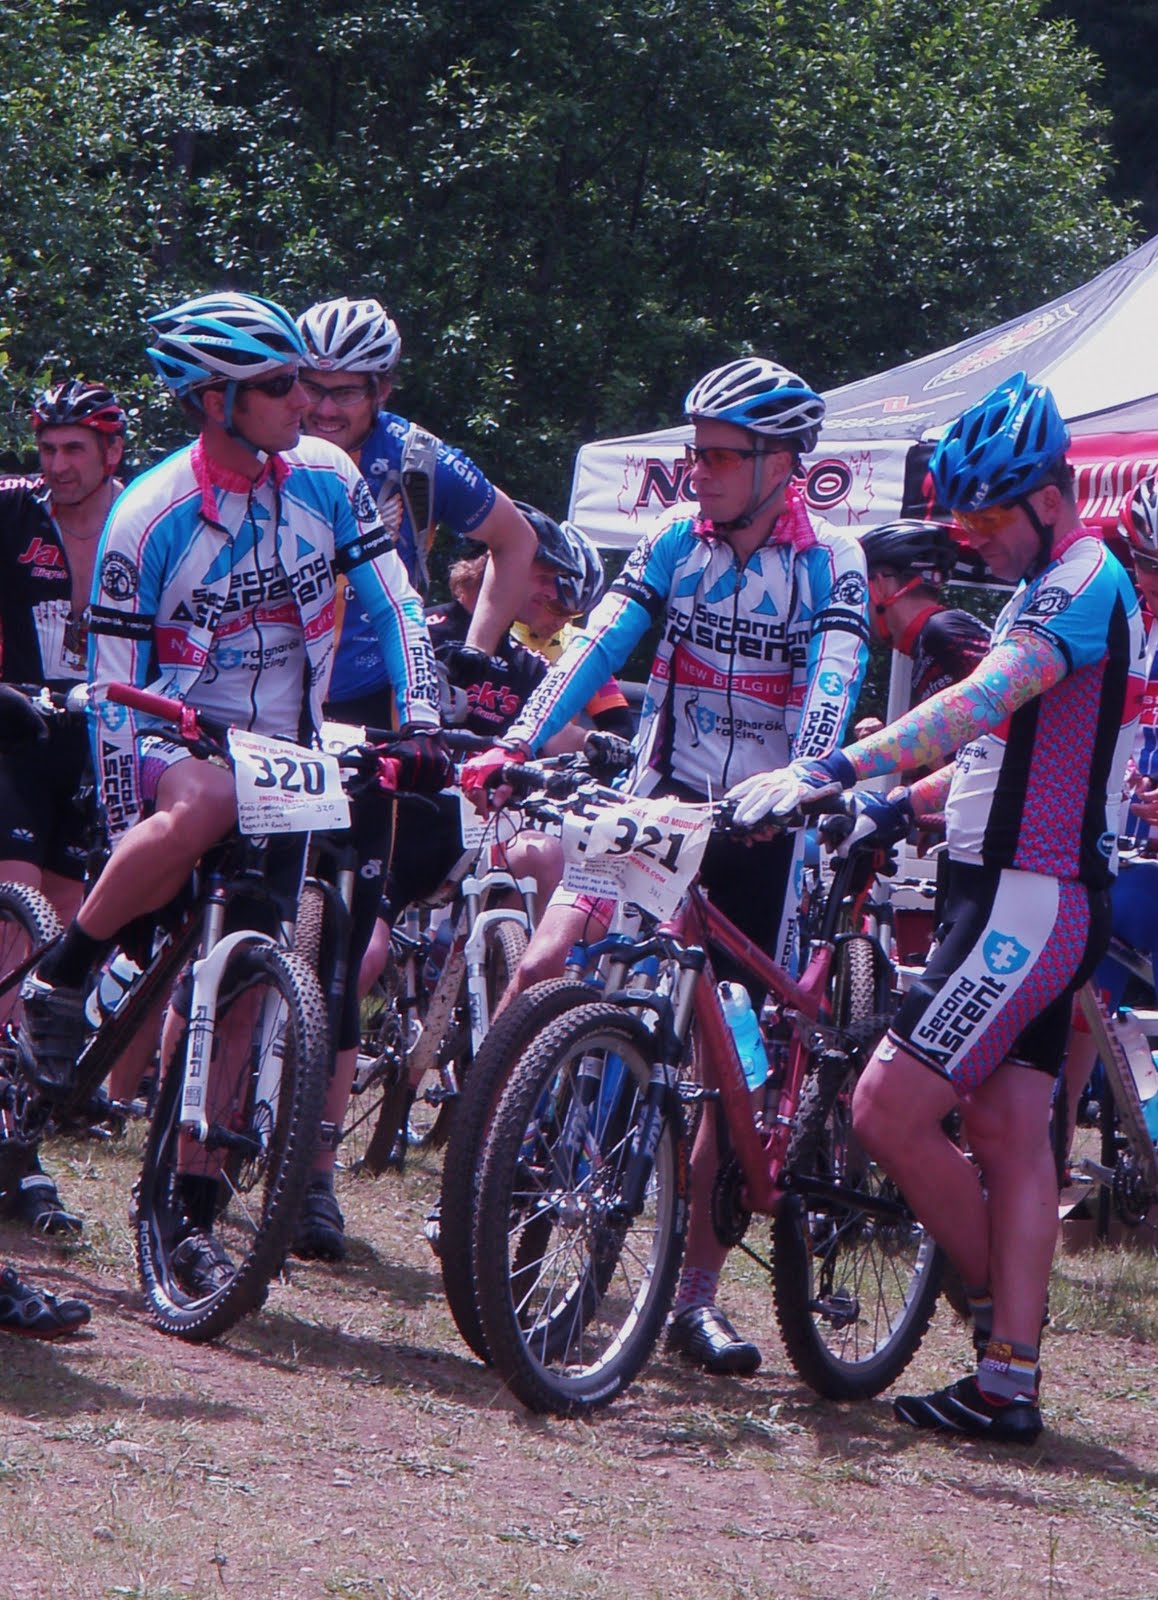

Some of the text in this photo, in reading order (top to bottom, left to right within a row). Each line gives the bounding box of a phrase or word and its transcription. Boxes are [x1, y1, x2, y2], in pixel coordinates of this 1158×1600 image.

[695, 602, 786, 640] Second
[807, 701, 839, 759] scent
[119, 754, 139, 816] Secod
[249, 754, 325, 796] 320
[605, 817, 686, 875] 321
[918, 976, 976, 1043] Second
[923, 975, 1008, 1066] Ascent
